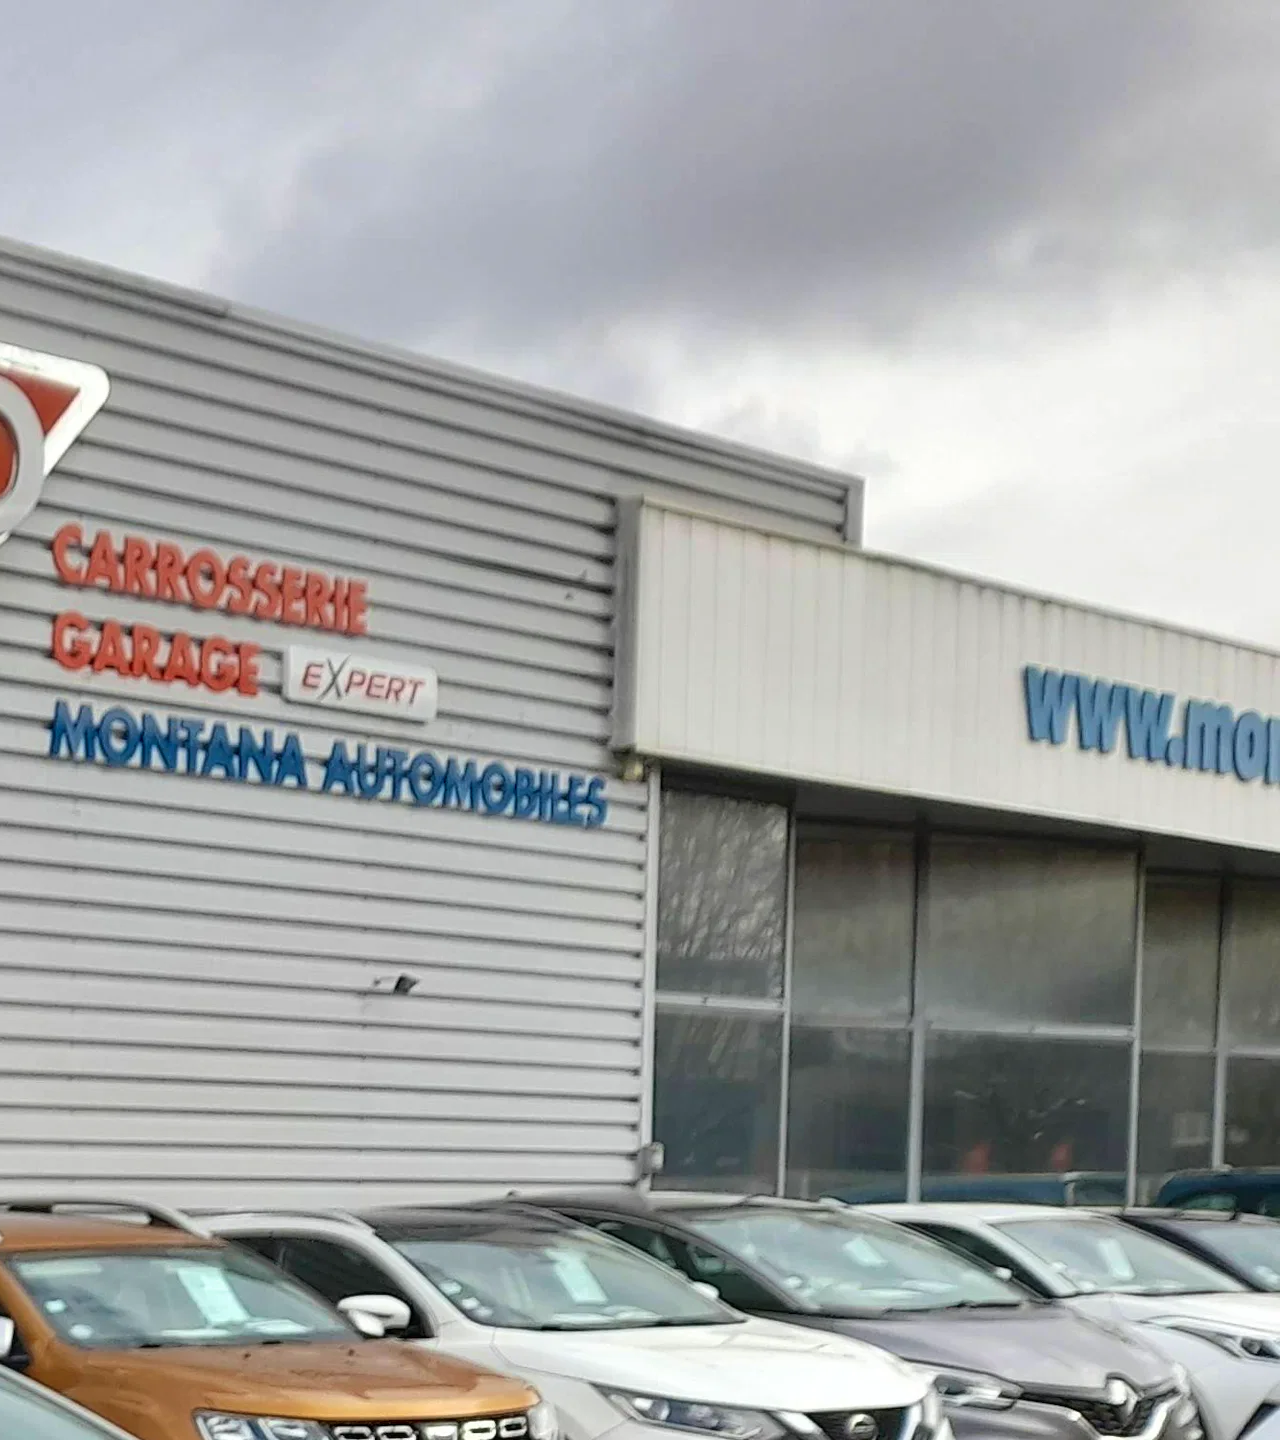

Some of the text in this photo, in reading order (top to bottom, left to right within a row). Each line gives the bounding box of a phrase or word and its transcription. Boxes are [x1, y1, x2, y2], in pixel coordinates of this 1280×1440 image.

[52, 524, 368, 635] CARROSSERIE
[52, 613, 259, 697] GARAGE
[49, 702, 608, 828] MONTANA AUTOMOBILES
